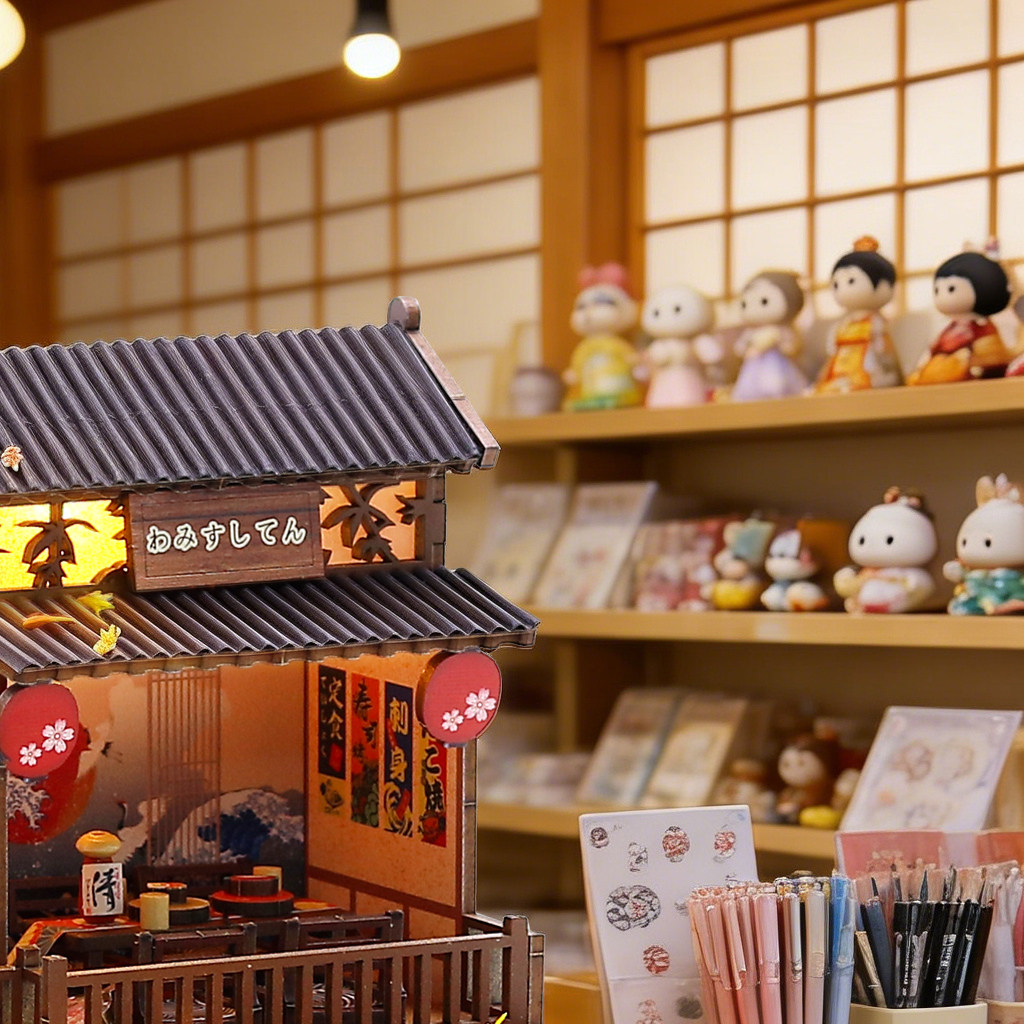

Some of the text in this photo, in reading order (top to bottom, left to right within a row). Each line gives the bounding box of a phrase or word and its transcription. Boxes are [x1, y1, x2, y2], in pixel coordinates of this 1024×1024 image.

[146, 515, 307, 555] わみすしてん
[389, 697, 409, 783] 刺身
